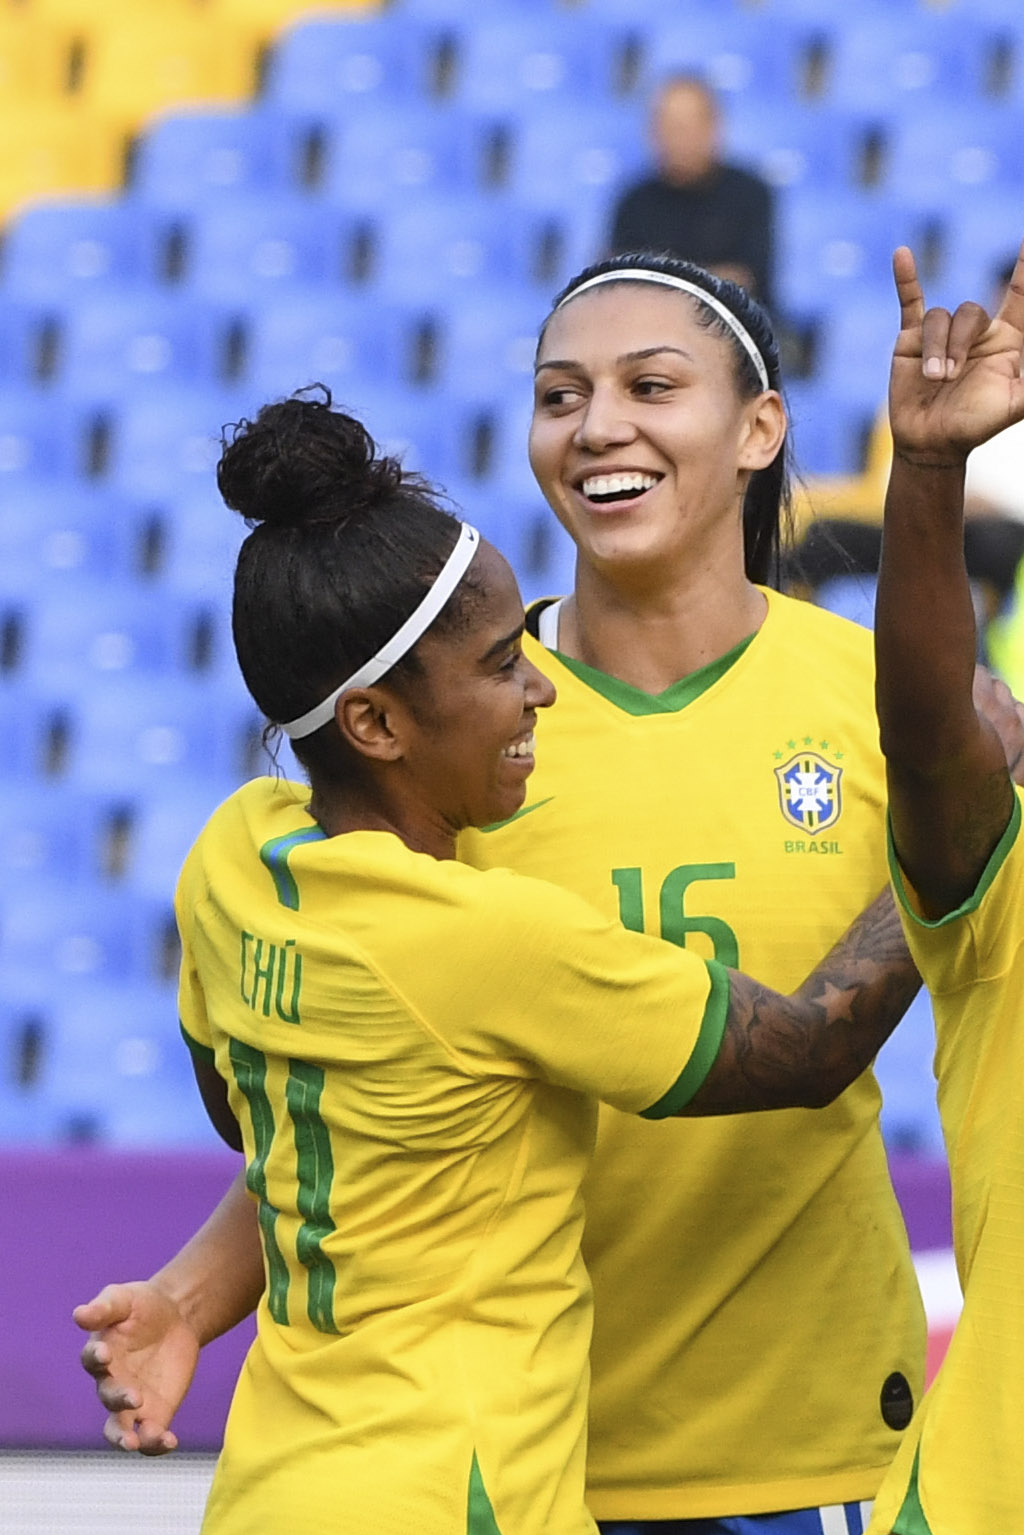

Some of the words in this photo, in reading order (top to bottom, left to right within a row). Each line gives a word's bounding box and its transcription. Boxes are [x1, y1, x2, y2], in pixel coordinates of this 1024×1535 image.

[798, 787, 819, 796] CBF
[784, 840, 843, 854] BRASIL
[612, 862, 739, 970] 16
[229, 1036, 341, 1335] 11
